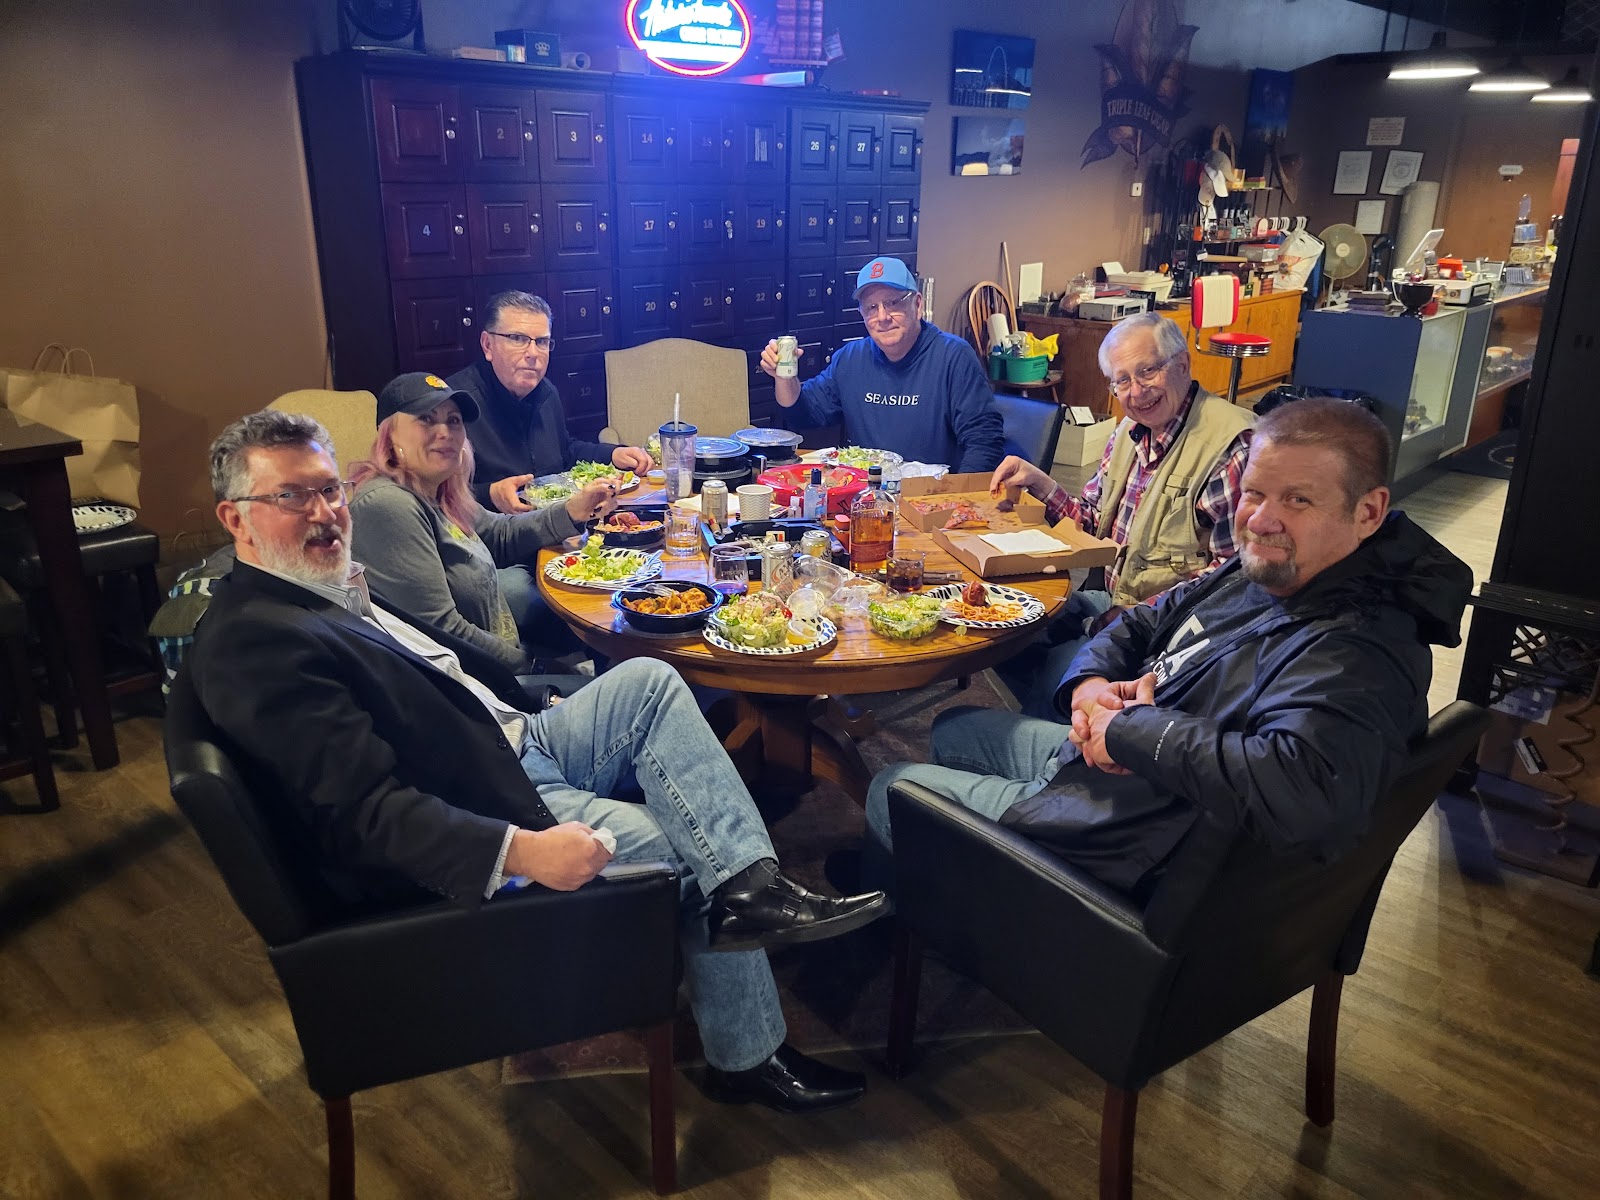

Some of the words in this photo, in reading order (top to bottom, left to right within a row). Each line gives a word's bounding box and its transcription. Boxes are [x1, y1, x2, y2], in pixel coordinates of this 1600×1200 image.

[1106, 98, 1133, 118] TRIPLE
[497, 127, 505, 139] 2
[570, 131, 578, 142] 3
[641, 132, 653, 143] 14
[810, 141, 820, 151] 26
[857, 142, 866, 152] 27
[898, 145, 908, 155] 28
[703, 218, 713, 229] 18
[756, 218, 766, 229] 19
[808, 216, 818, 226] 29
[853, 215, 862, 225] 30
[896, 215, 905, 224] 31
[422, 224, 431, 236] 4
[503, 222, 511, 234] 5
[575, 221, 583, 232] 6
[644, 220, 655, 231] 17
[869, 261, 884, 279] B
[755, 292, 766, 302] 22
[807, 288, 817, 298] 32
[645, 301, 656, 312] 20
[703, 296, 713, 307] 21
[580, 307, 587, 318] 9
[432, 319, 440, 331] 7
[864, 392, 920, 406] SEASIDE
